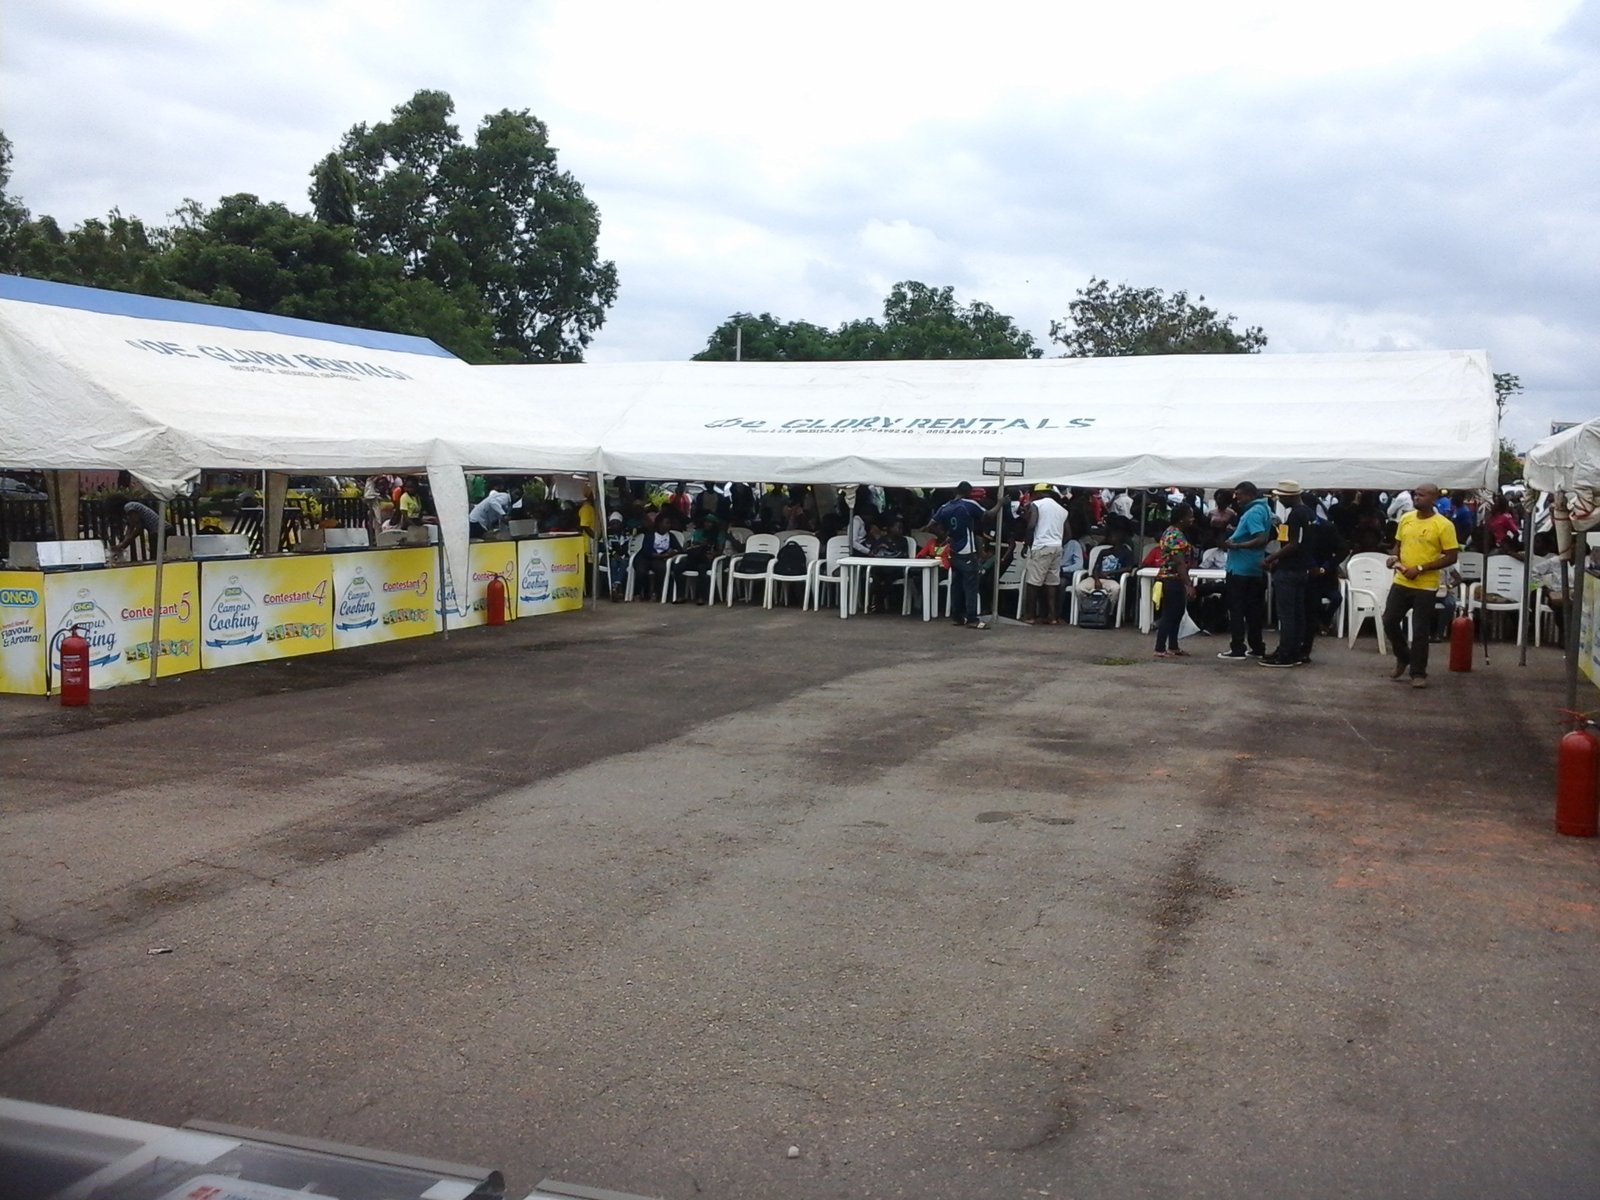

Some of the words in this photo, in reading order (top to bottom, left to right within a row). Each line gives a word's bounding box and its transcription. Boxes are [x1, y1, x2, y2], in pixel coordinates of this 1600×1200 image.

[196, 345, 298, 369] GLORY
[292, 353, 414, 381] RENTALS
[781, 416, 904, 429] GLORY
[905, 418, 1097, 430] RENTALS
[950, 516, 957, 530] 9
[383, 580, 419, 592] Contestant
[416, 571, 428, 595] 3
[1, 591, 35, 604] ONGA
[263, 591, 311, 604] Contestant
[312, 580, 327, 605] 4
[74, 602, 94, 612] ONGA
[121, 603, 178, 620] Contetant
[178, 591, 191, 622] 5
[217, 601, 251, 615] Campus
[340, 599, 376, 617] Cooking
[208, 612, 259, 631] Cooking
[1, 626, 33, 639] Flavour
